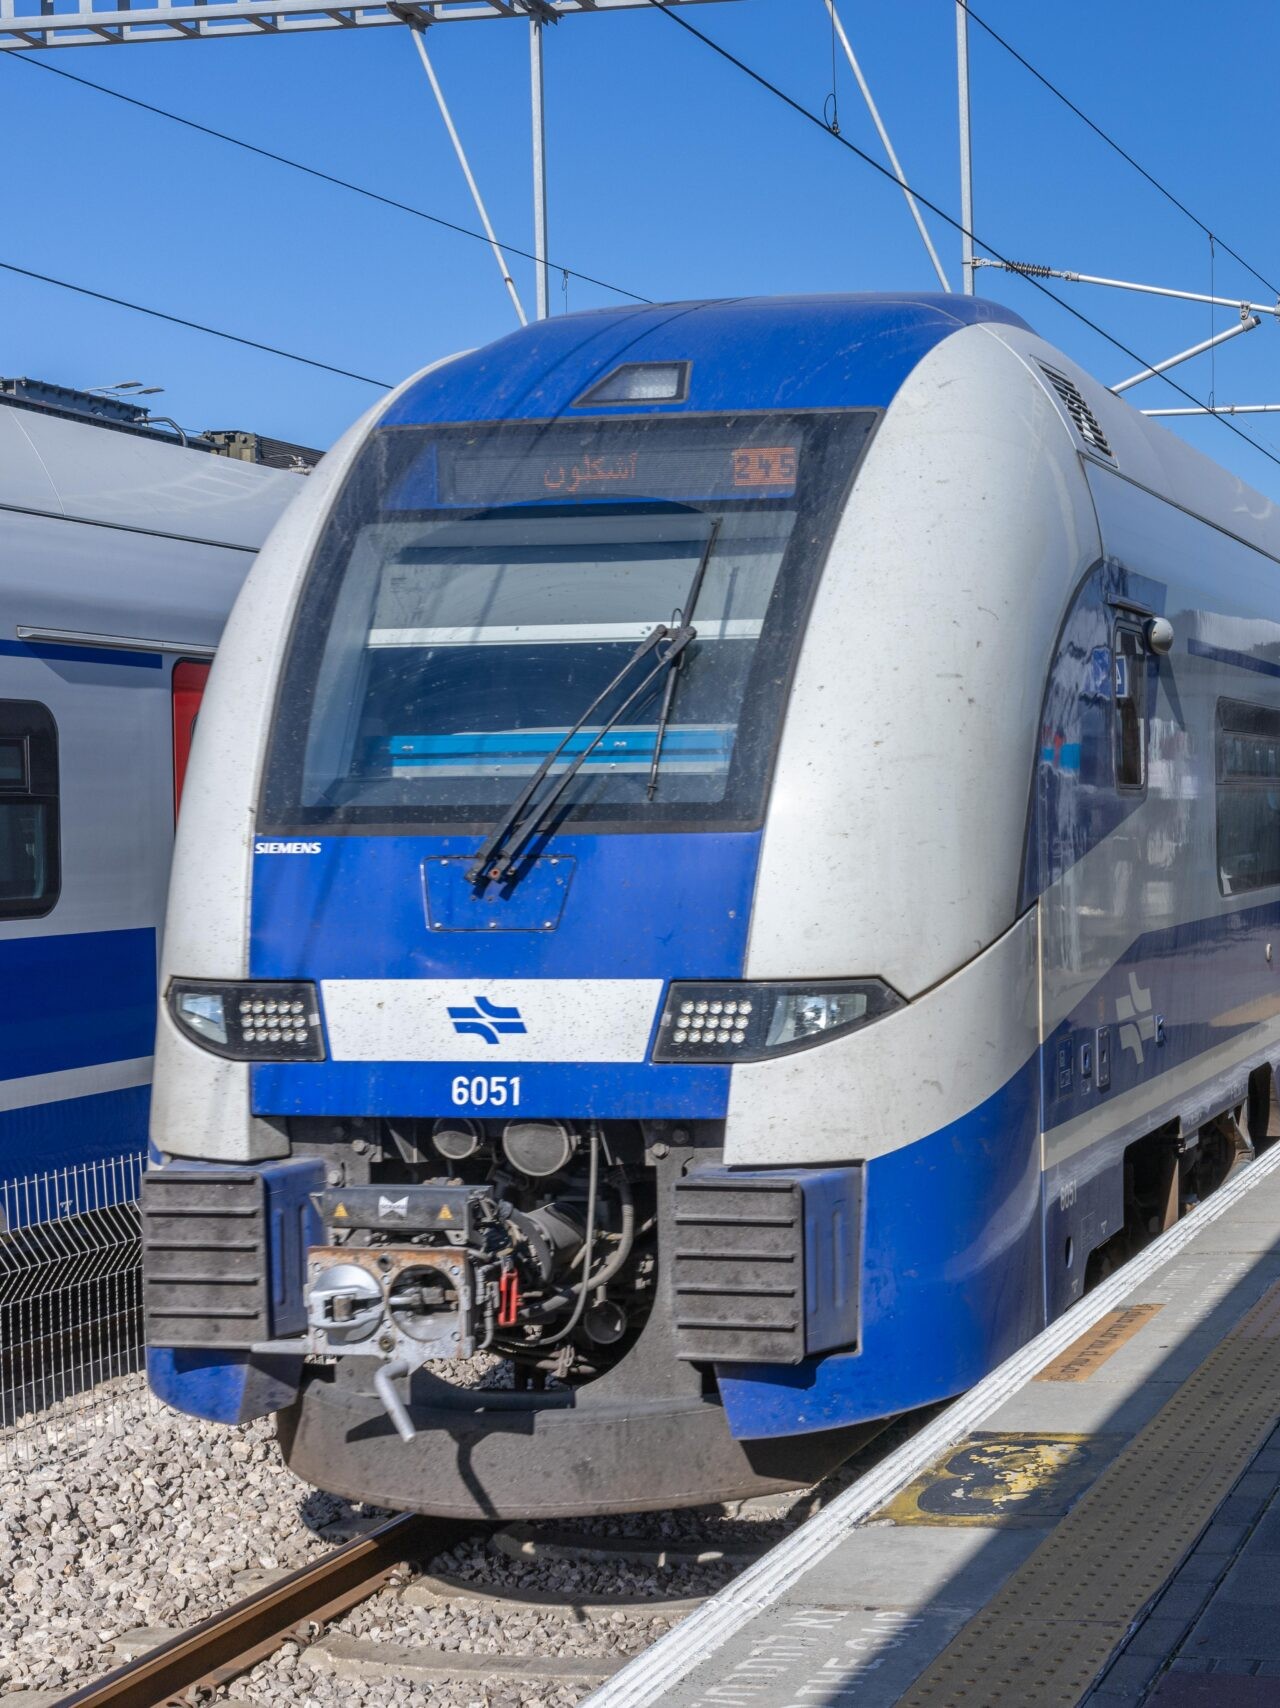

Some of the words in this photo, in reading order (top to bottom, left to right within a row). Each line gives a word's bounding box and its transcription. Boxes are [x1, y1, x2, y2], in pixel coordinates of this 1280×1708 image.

[736, 454, 796, 480] 245
[255, 842, 322, 854] SIEMENS
[452, 1076, 520, 1106] 6051
[1060, 1179, 1078, 1212] 6051
[781, 1610, 850, 1629] נא
[793, 1657, 886, 1697] THE
[845, 1611, 925, 1650] GAP
